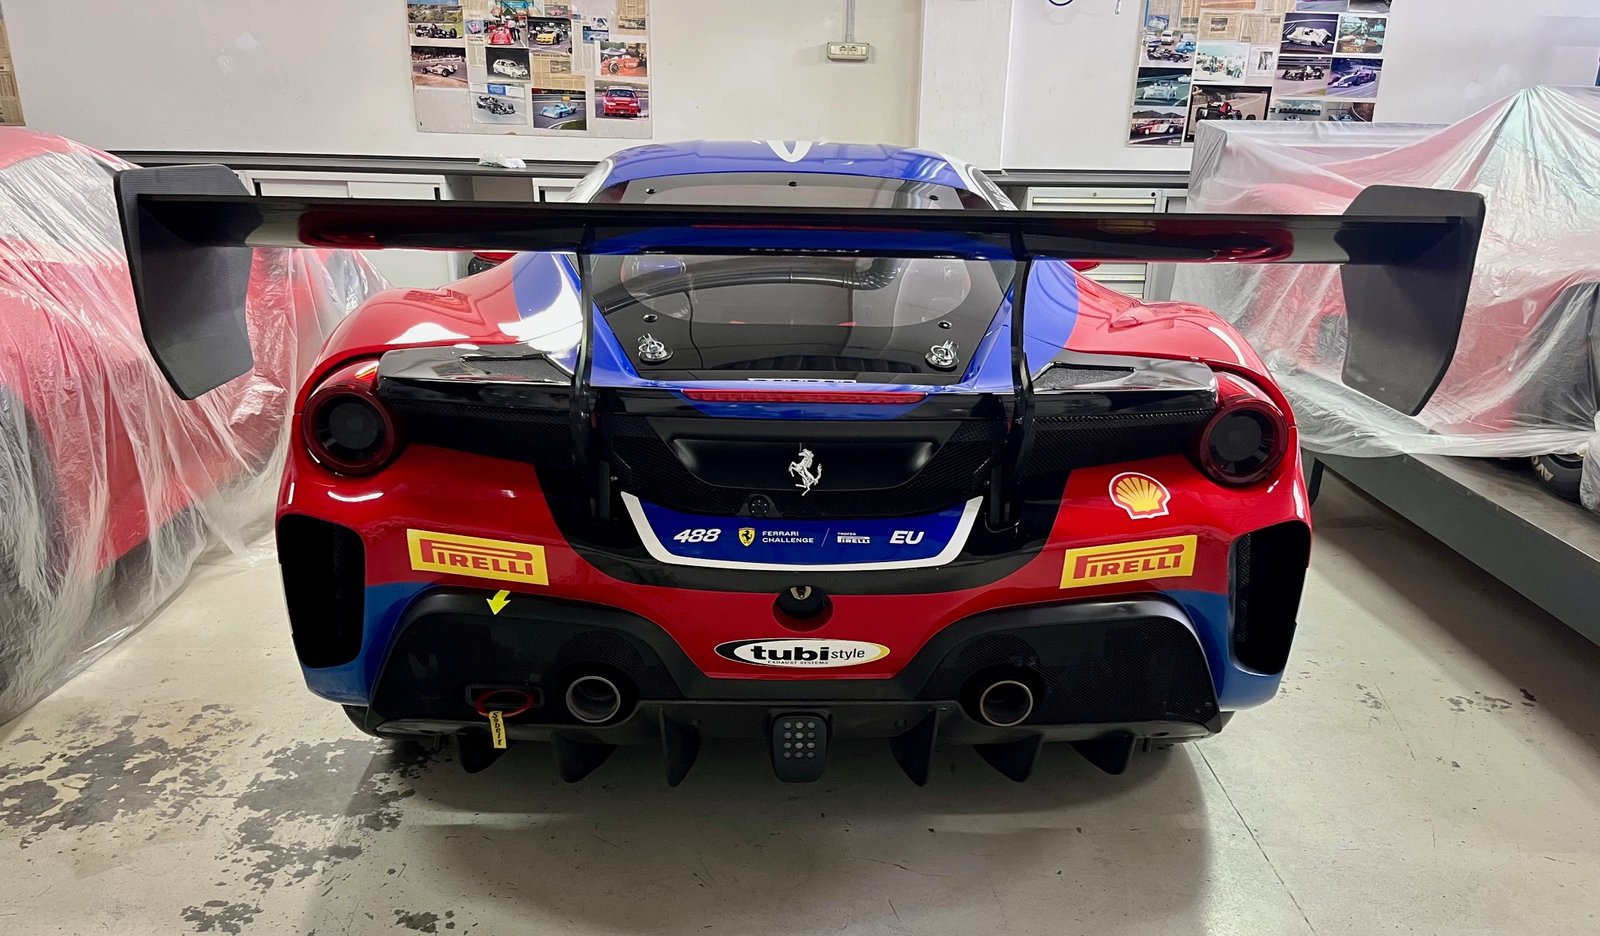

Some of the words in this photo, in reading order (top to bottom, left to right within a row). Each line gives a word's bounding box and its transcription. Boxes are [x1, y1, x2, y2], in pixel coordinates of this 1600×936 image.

[673, 528, 721, 543] 488
[836, 536, 870, 544] PIRELLI
[889, 530, 925, 545] EU
[419, 538, 533, 576] PIRELLI
[1073, 544, 1185, 579] PIRELLI
[750, 645, 829, 660] tubi
[830, 648, 865, 660] style
